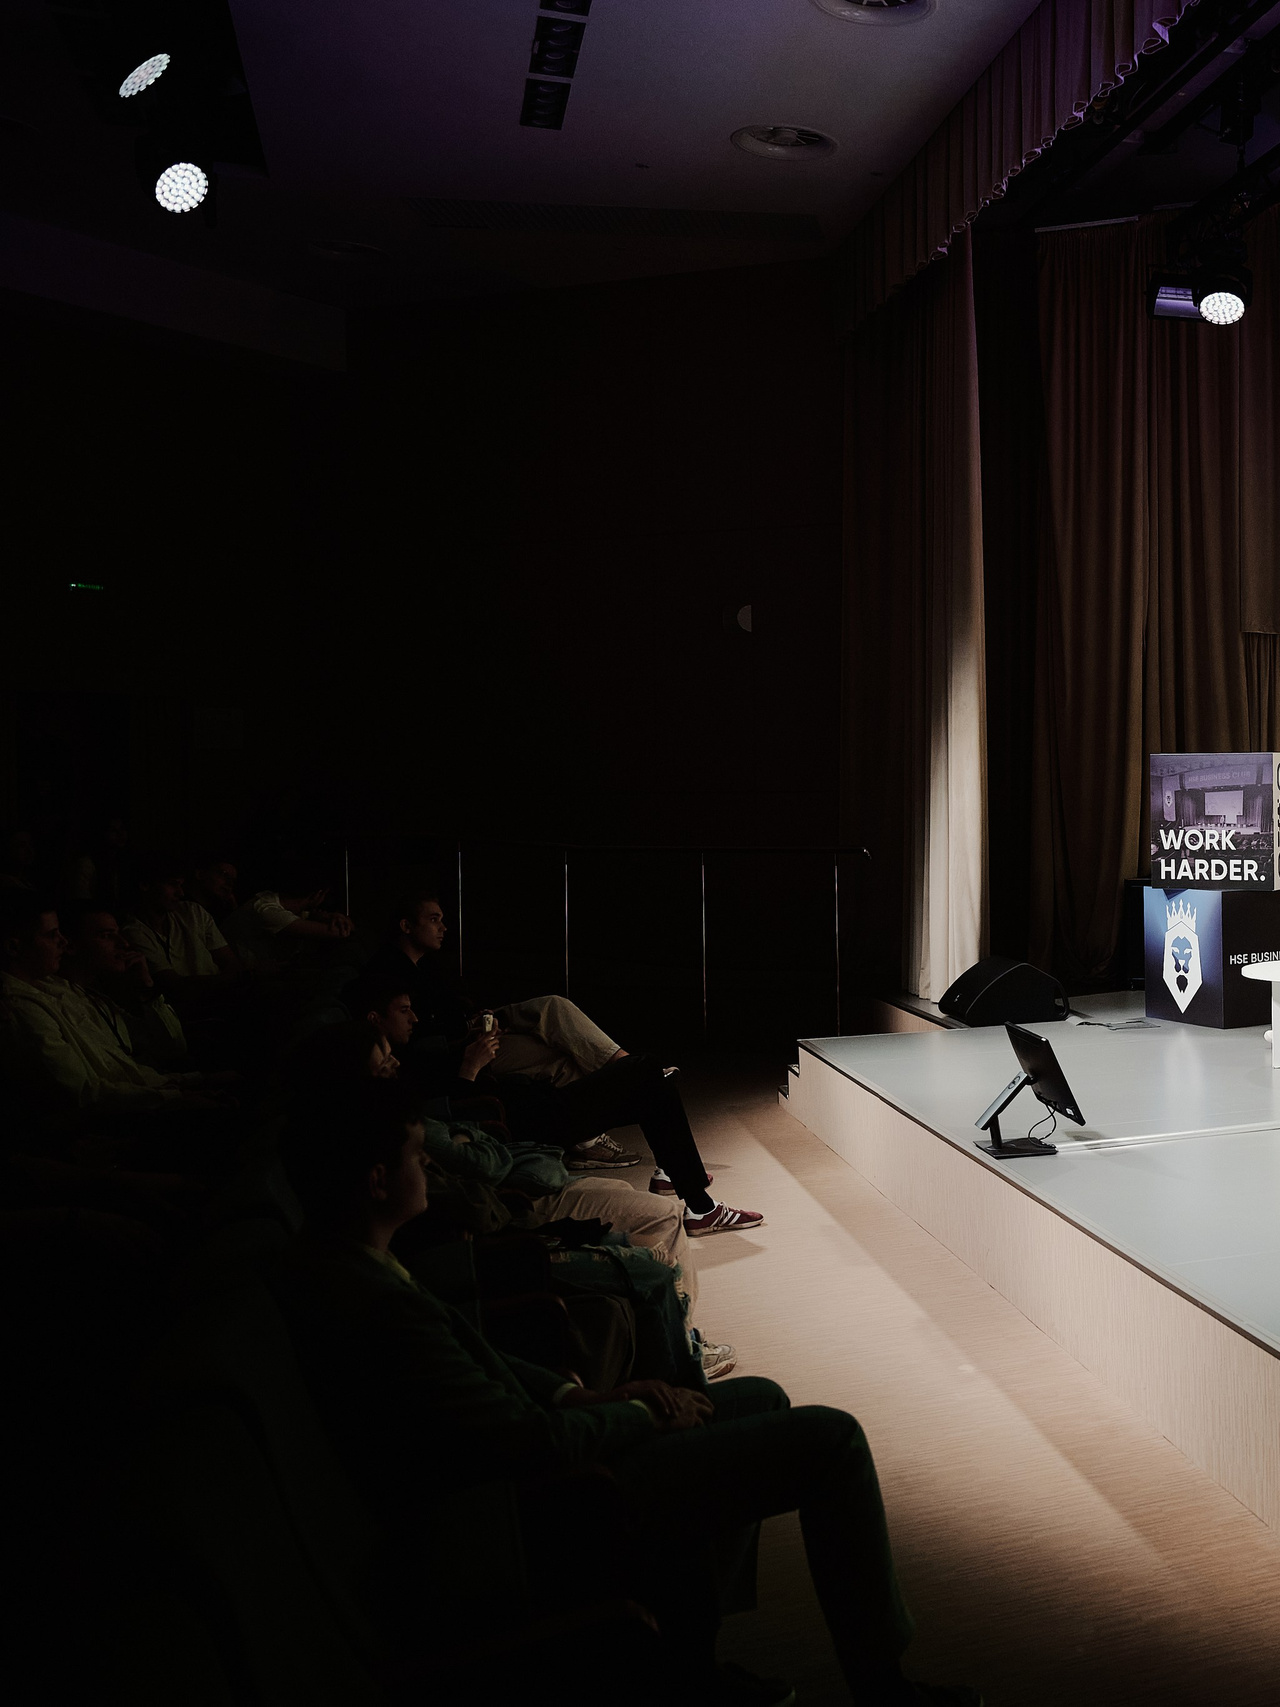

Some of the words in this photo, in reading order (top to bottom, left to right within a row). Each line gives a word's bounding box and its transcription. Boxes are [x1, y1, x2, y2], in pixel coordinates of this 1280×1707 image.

[1159, 828, 1237, 851] WORK
[1160, 858, 1266, 882] HARDER.
[1229, 953, 1249, 965] HSE
